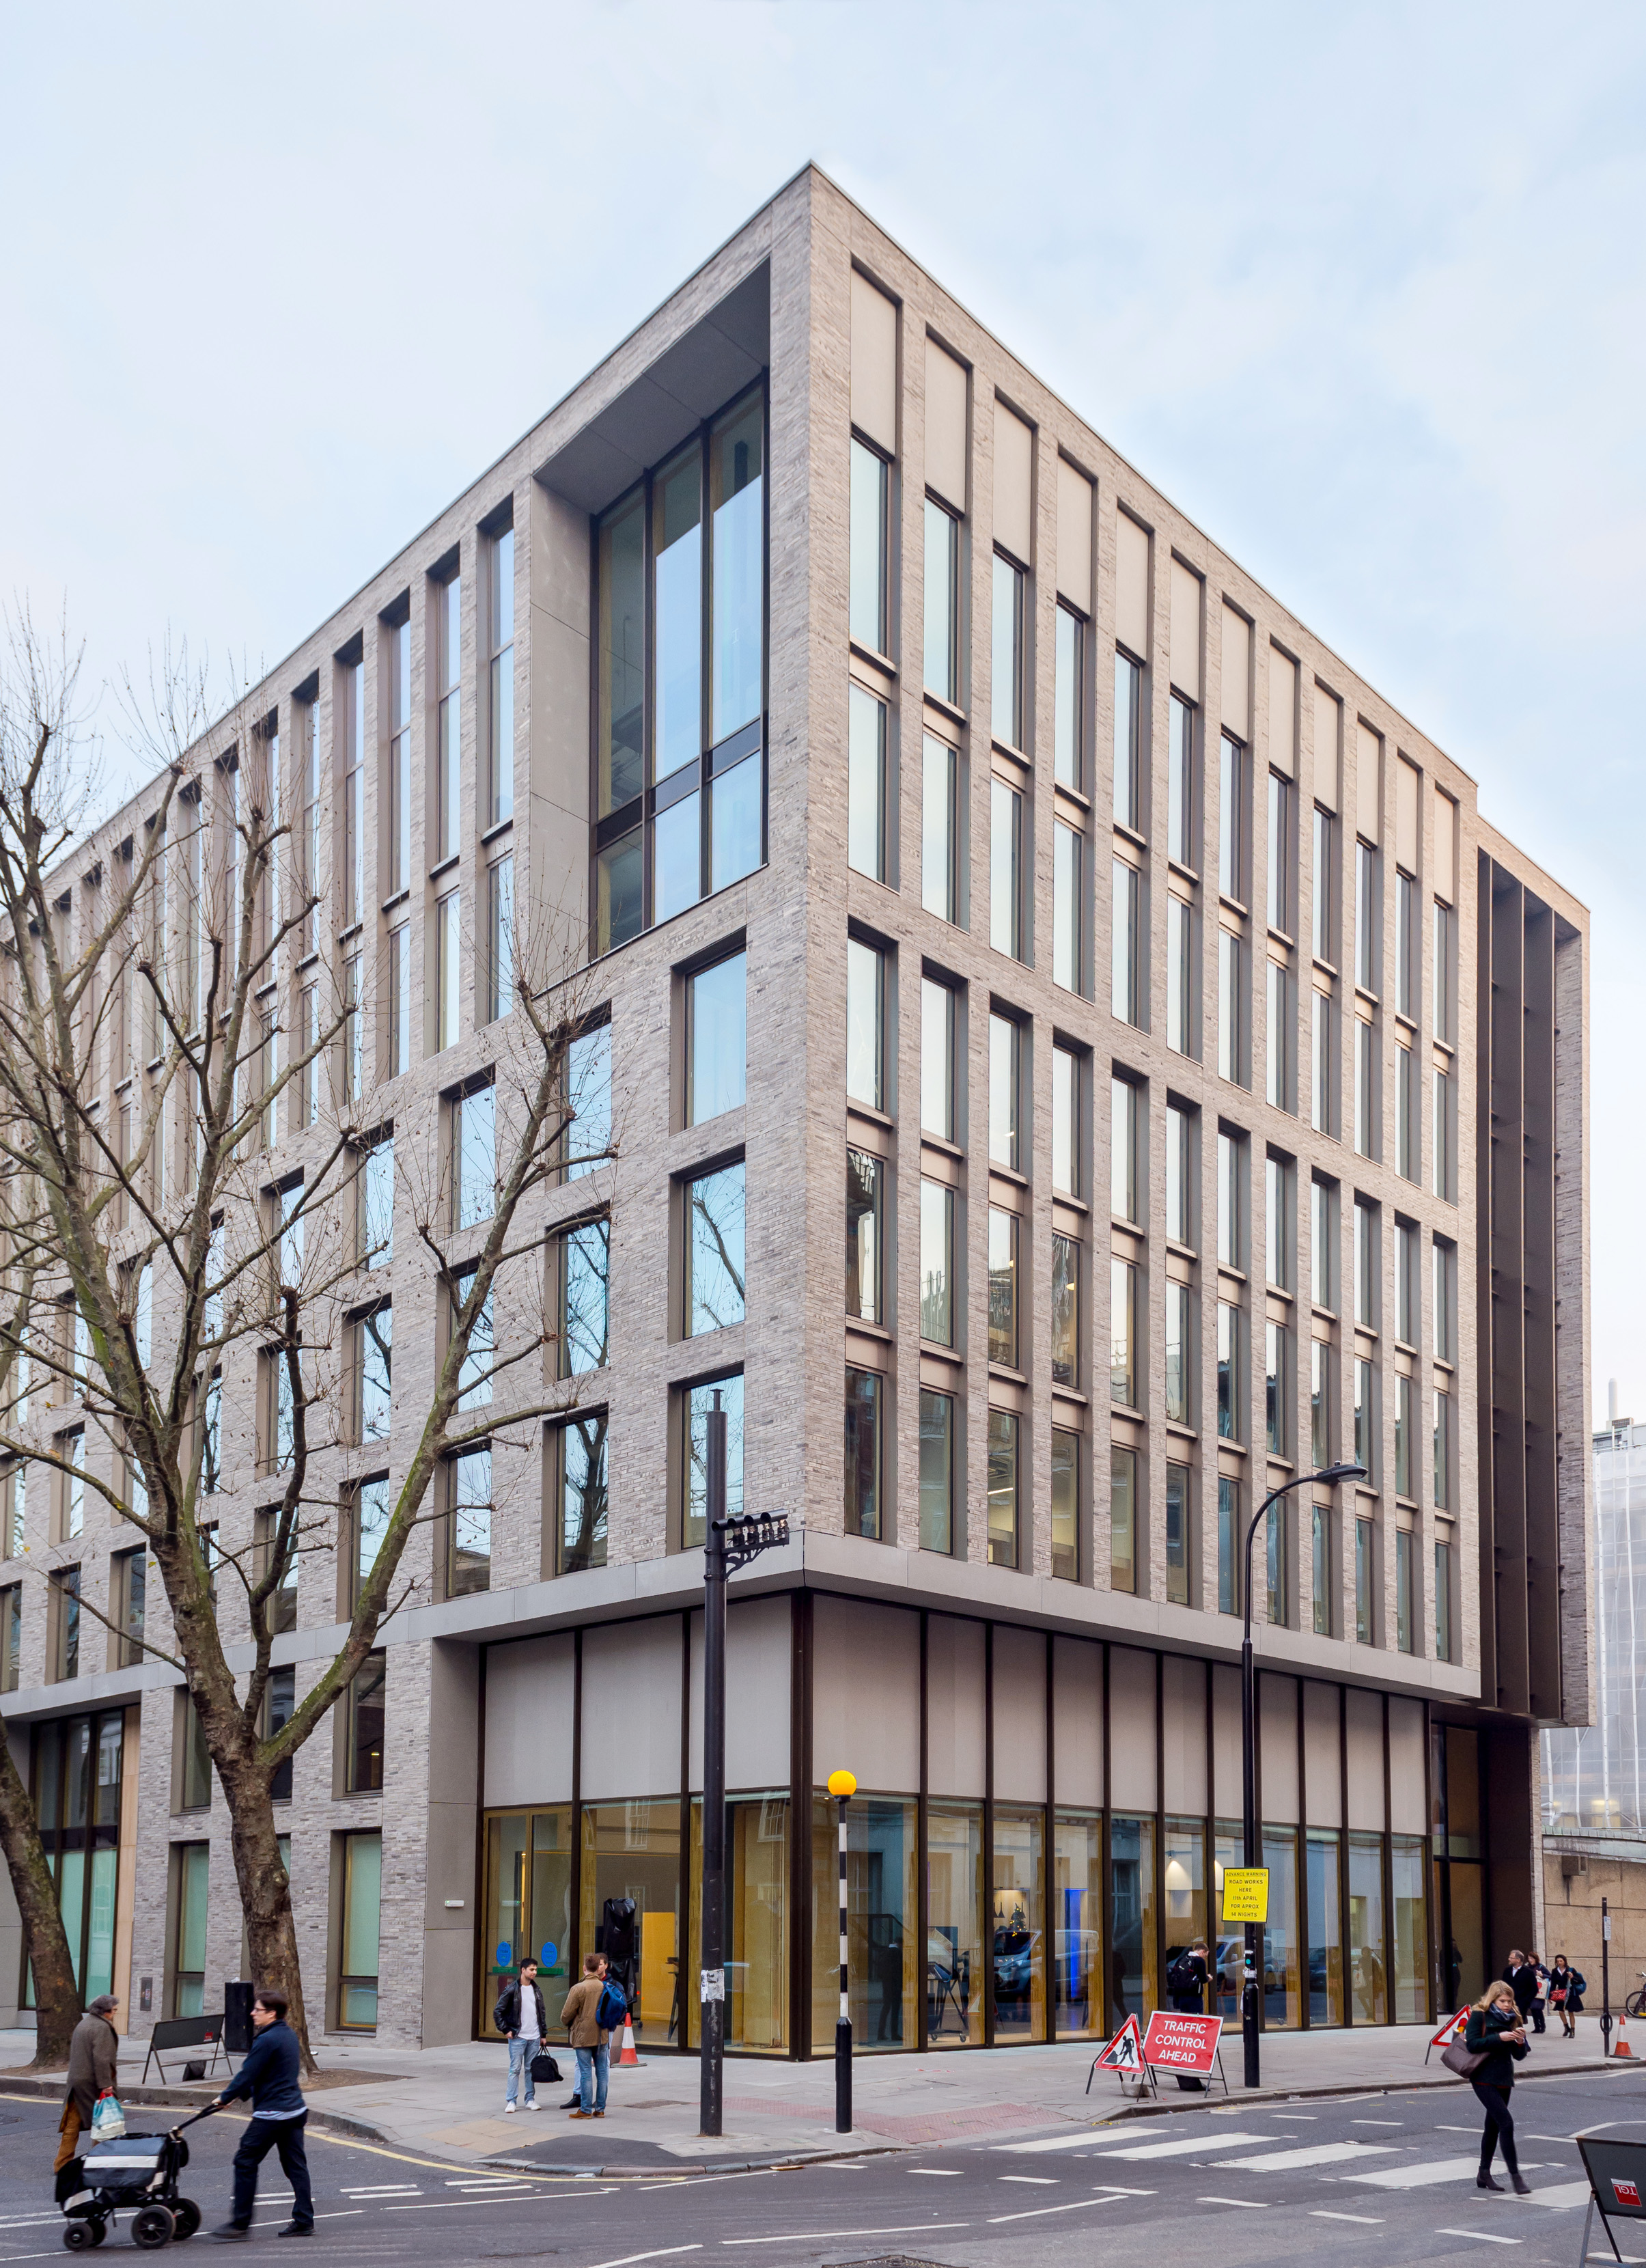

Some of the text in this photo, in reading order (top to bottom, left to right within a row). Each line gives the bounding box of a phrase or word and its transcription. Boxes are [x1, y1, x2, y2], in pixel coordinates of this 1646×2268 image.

[1164, 2020, 1206, 2034] TRAFFIC
[1155, 2034, 1206, 2049] CONTROL
[1158, 2049, 1196, 2063] AHEAD
[1614, 2185, 1637, 2196] TGL
